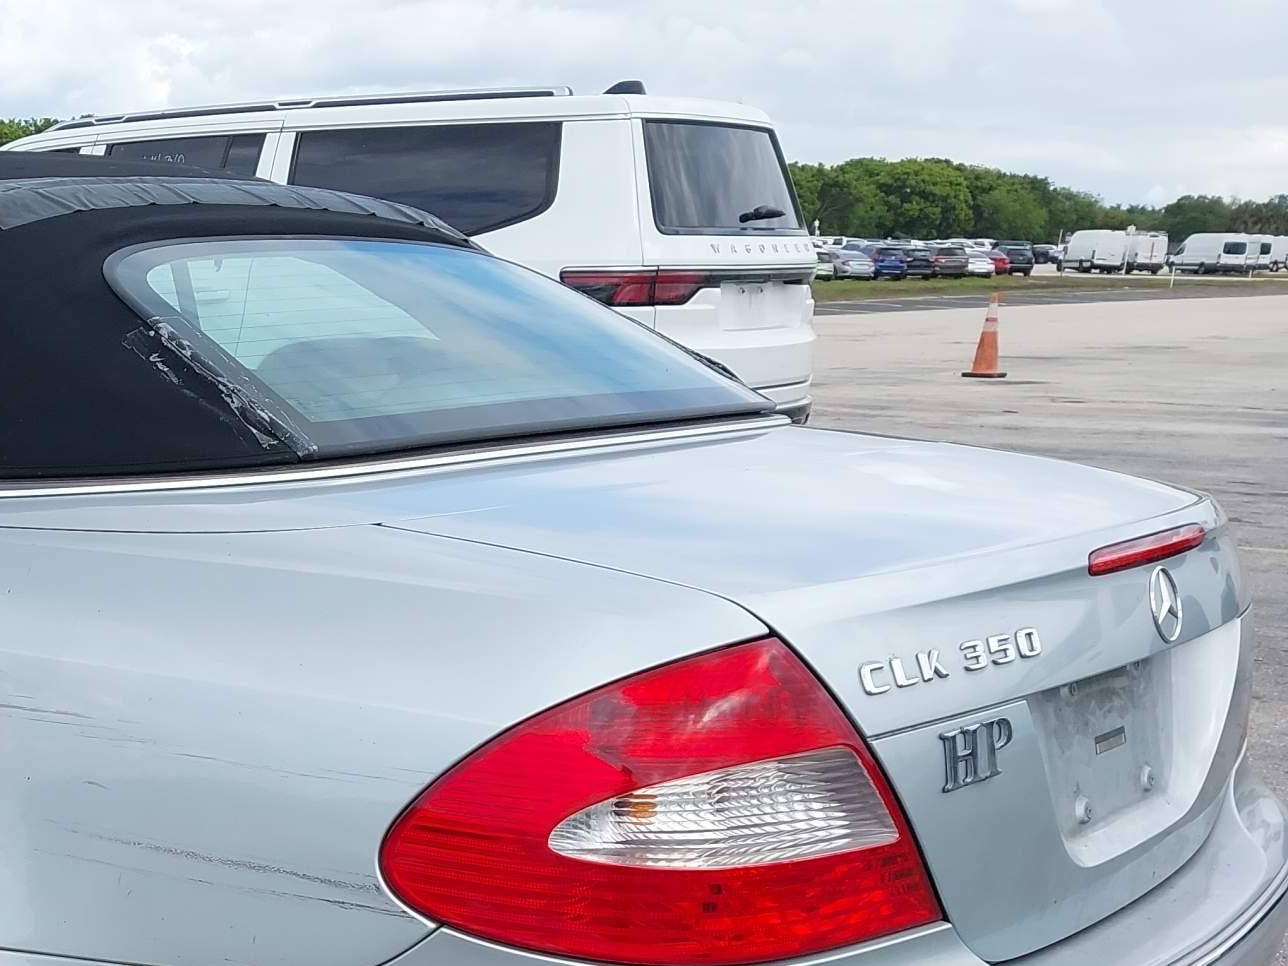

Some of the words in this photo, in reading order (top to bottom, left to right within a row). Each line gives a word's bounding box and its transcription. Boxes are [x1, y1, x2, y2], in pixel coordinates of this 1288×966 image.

[710, 243, 810, 254] WAGONEER
[859, 648, 950, 696] CLK
[959, 626, 1042, 672] 350
[938, 717, 1013, 793] HP
